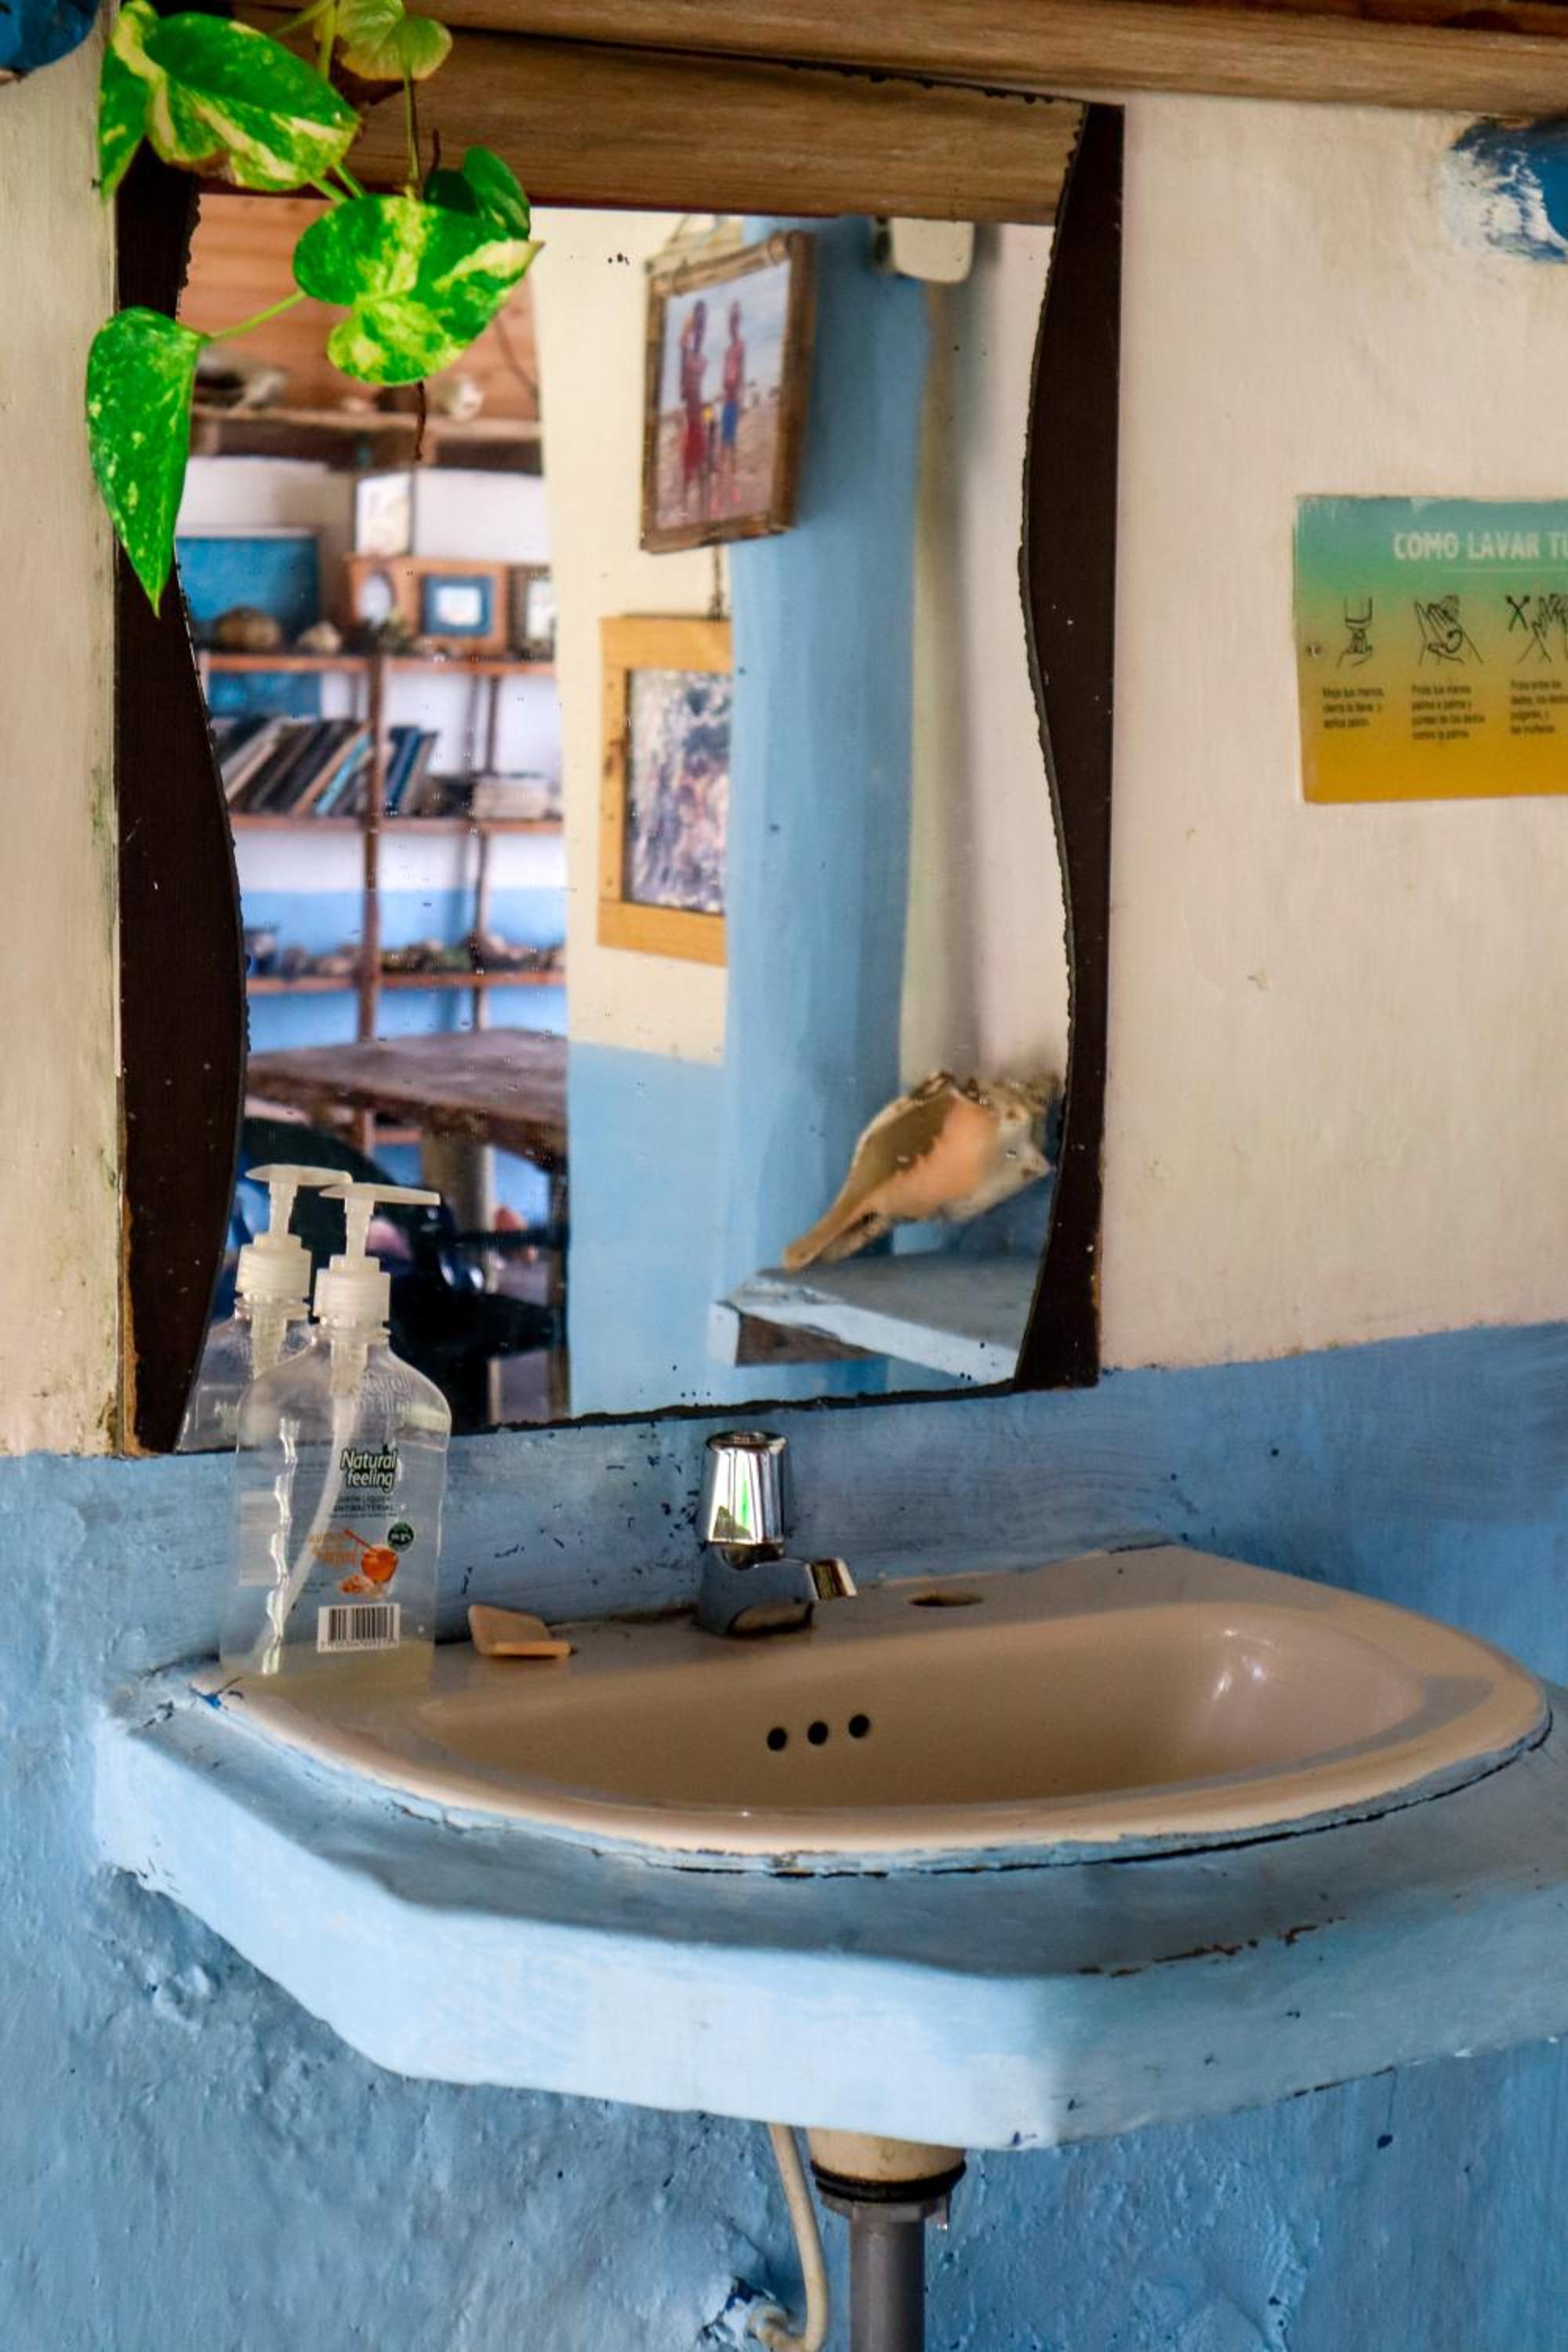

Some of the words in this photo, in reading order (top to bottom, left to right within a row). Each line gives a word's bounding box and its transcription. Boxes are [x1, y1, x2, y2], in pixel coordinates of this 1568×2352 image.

[1393, 532, 1459, 561] COMO
[1467, 531, 1540, 560] LAVAR
[340, 1447, 398, 1470] Natural
[346, 1468, 394, 1493] feeling
